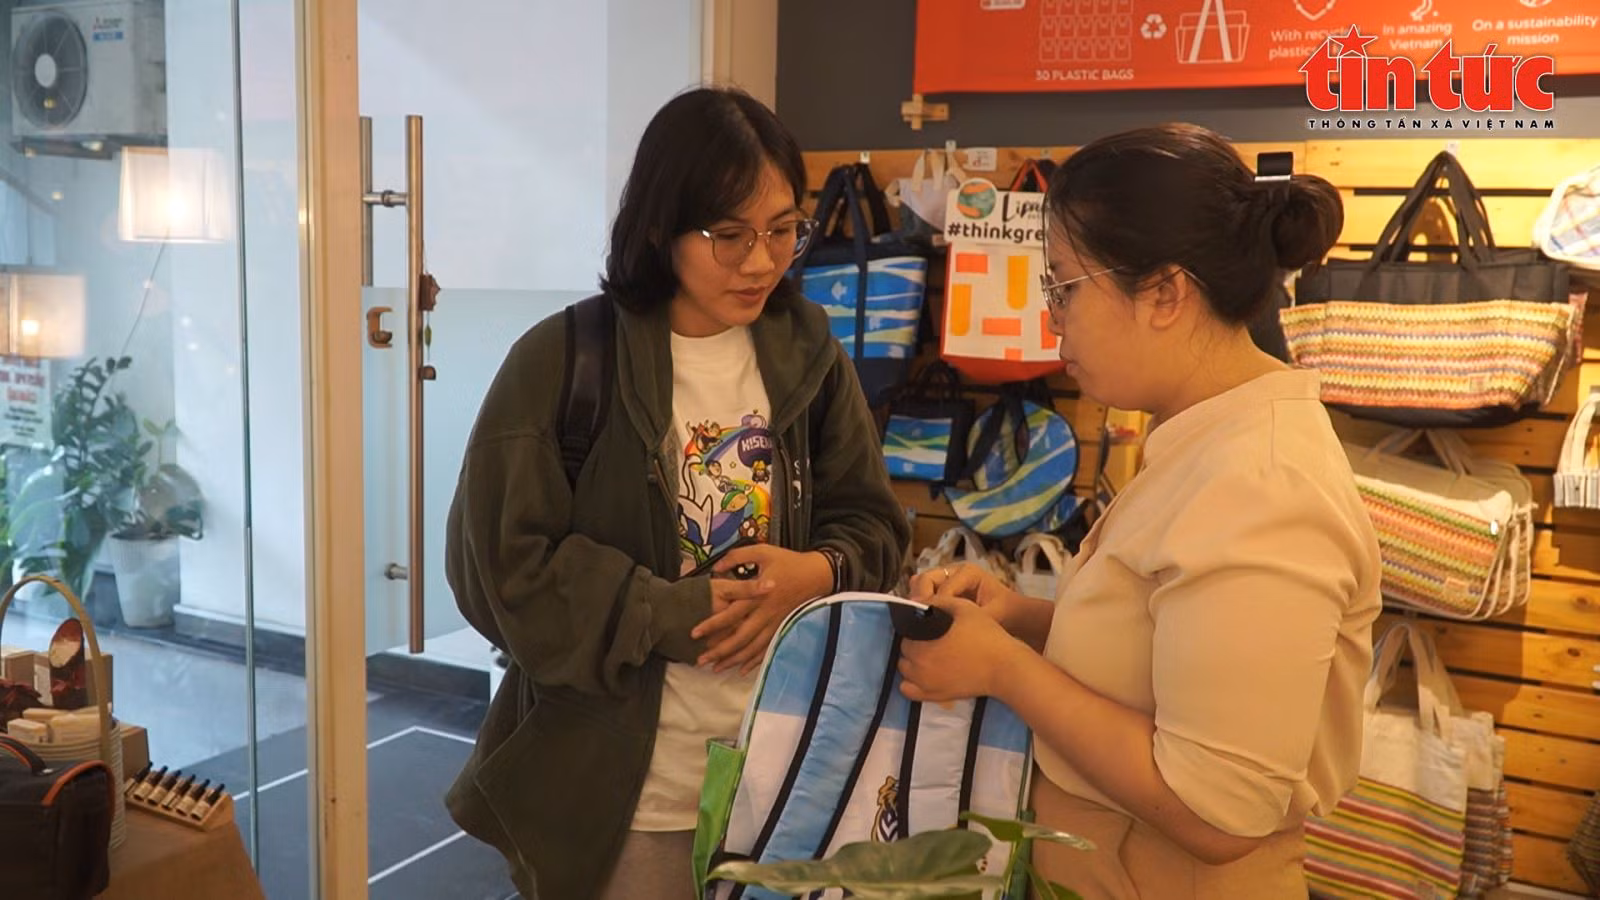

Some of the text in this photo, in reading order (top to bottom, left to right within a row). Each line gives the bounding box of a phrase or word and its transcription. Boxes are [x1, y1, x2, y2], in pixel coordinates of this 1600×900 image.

[1472, 14, 1598, 32] On a sustainability
[1271, 30, 1303, 41] With
[1383, 23, 1452, 36] In amazing
[1389, 39, 1442, 50] Vietnam
[1507, 33, 1560, 45] mission
[1036, 68, 1134, 81] 30 PLASTIC BAGS
